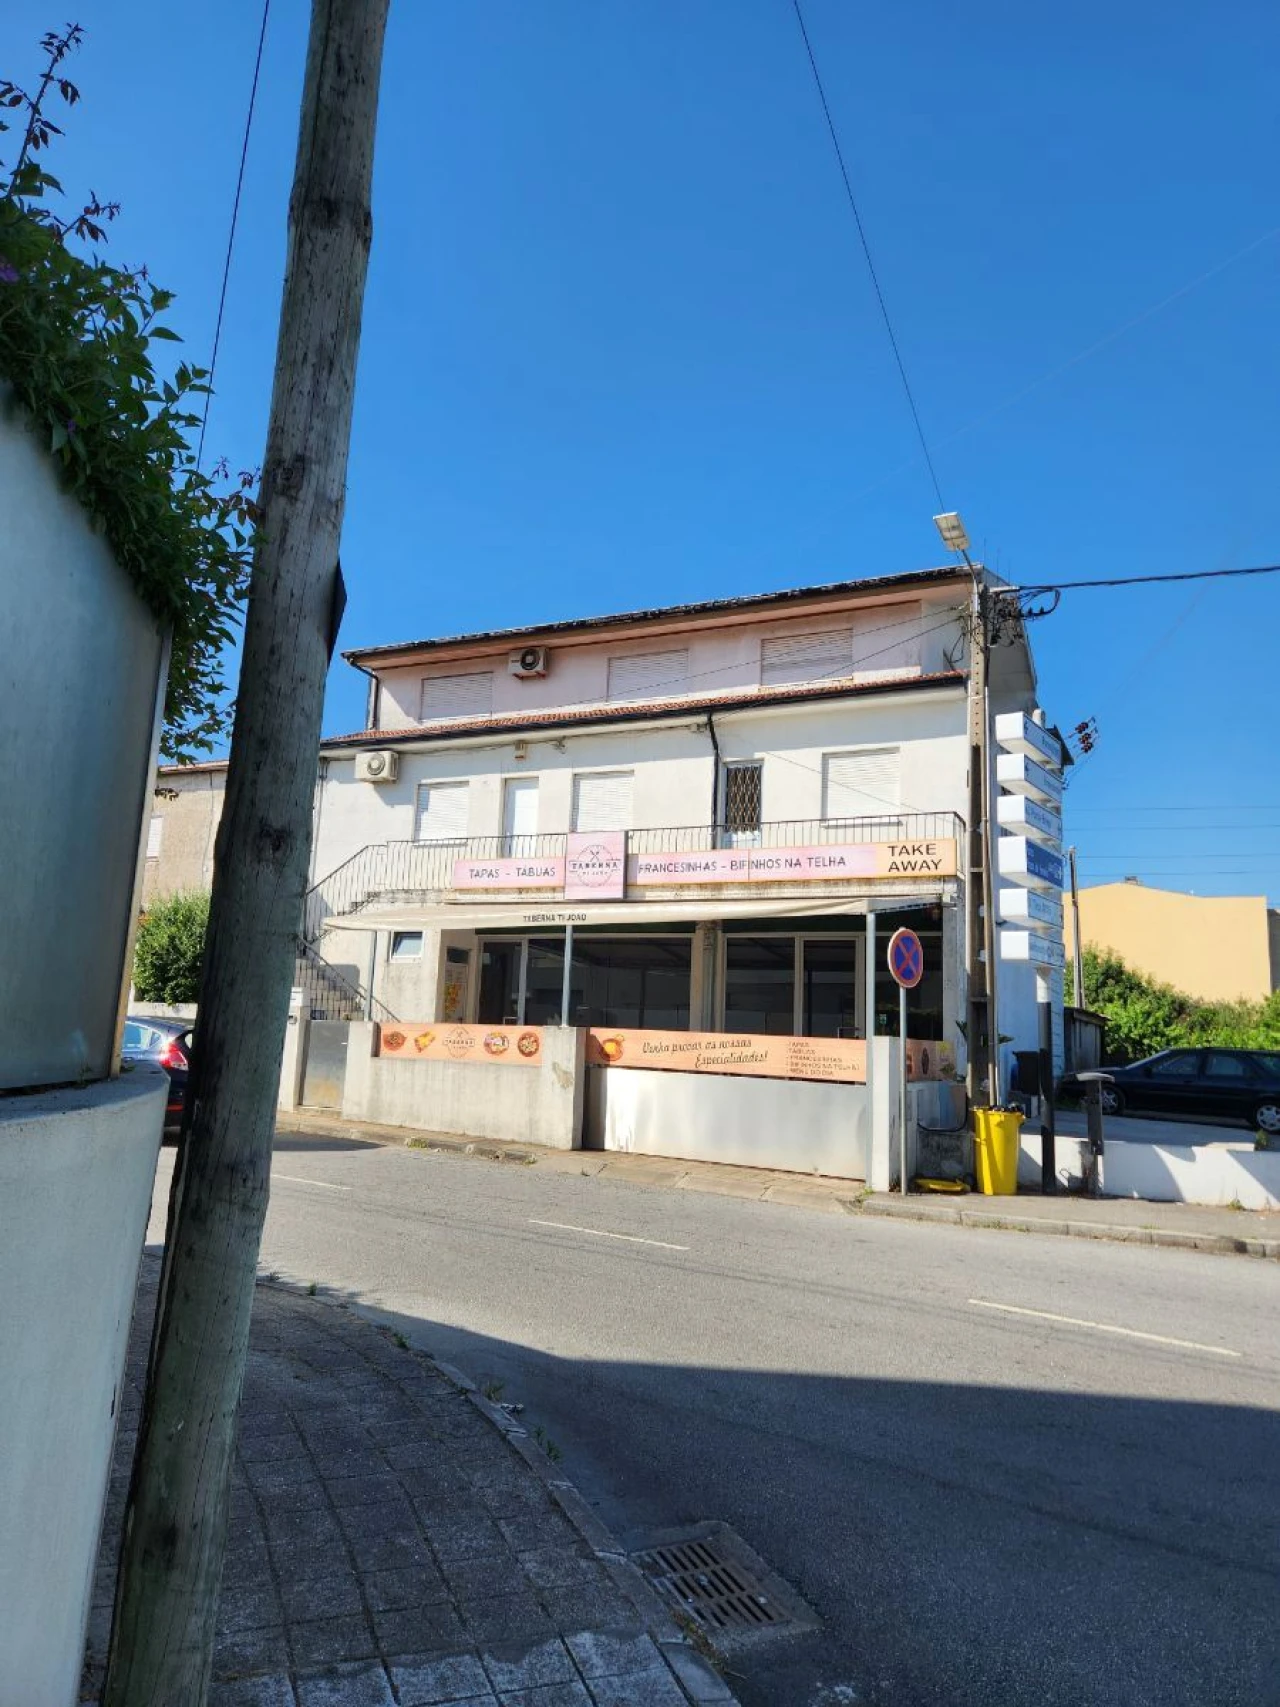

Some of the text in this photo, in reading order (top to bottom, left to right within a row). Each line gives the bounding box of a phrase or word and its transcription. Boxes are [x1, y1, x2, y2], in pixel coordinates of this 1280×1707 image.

[887, 843, 937, 857] TAKE
[638, 861, 717, 874] FRANCESINHAS
[730, 858, 781, 871] BIFINHOS
[784, 857, 802, 869] NA
[807, 856, 846, 868] TELHA
[888, 859, 942, 873] AWAY
[469, 868, 500, 879] TAPAS
[523, 914, 556, 922] TABERNA
